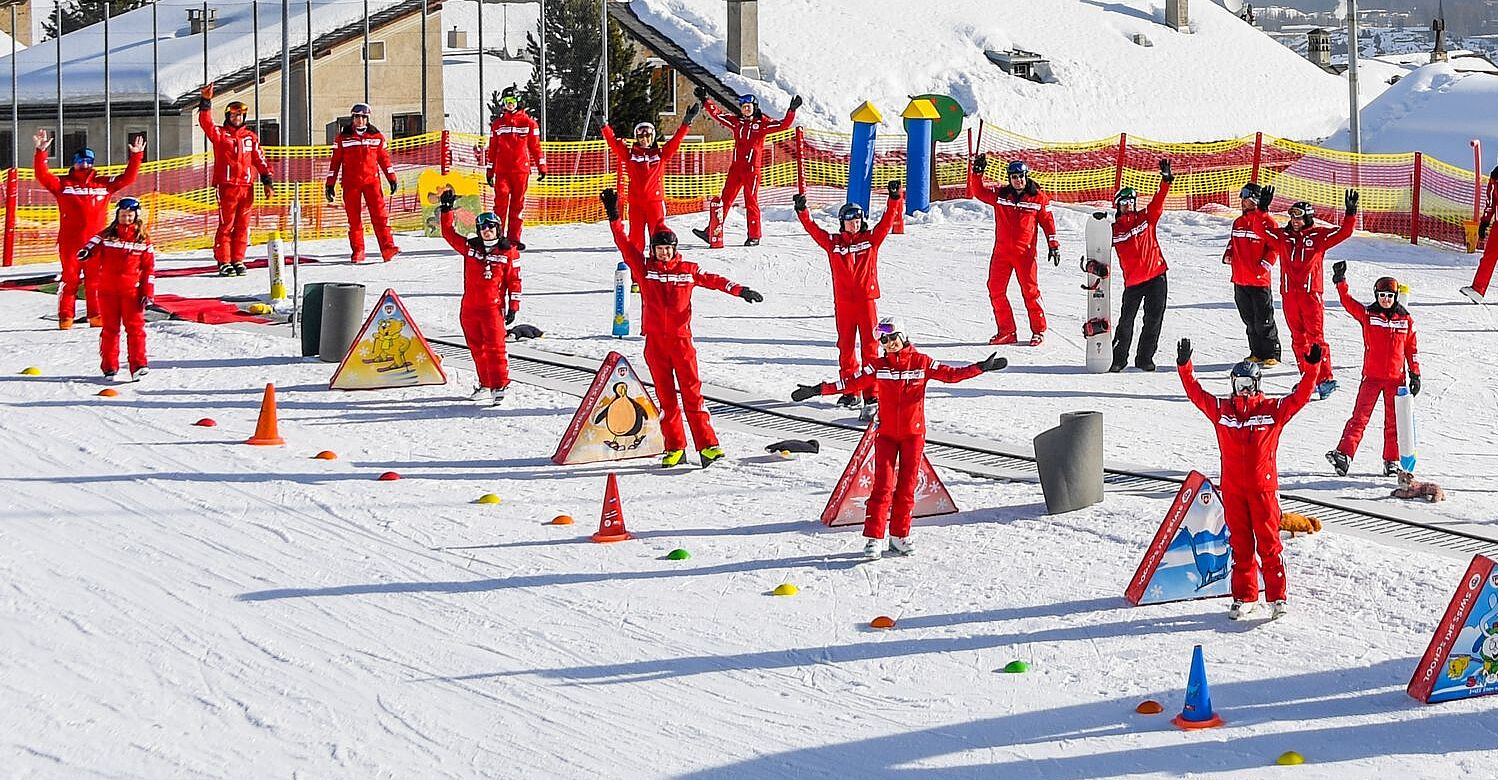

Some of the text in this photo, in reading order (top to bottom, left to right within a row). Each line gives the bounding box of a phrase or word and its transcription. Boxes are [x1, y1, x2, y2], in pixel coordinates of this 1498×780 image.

[1422, 591, 1472, 683] SWISS SKI SCHOOL
